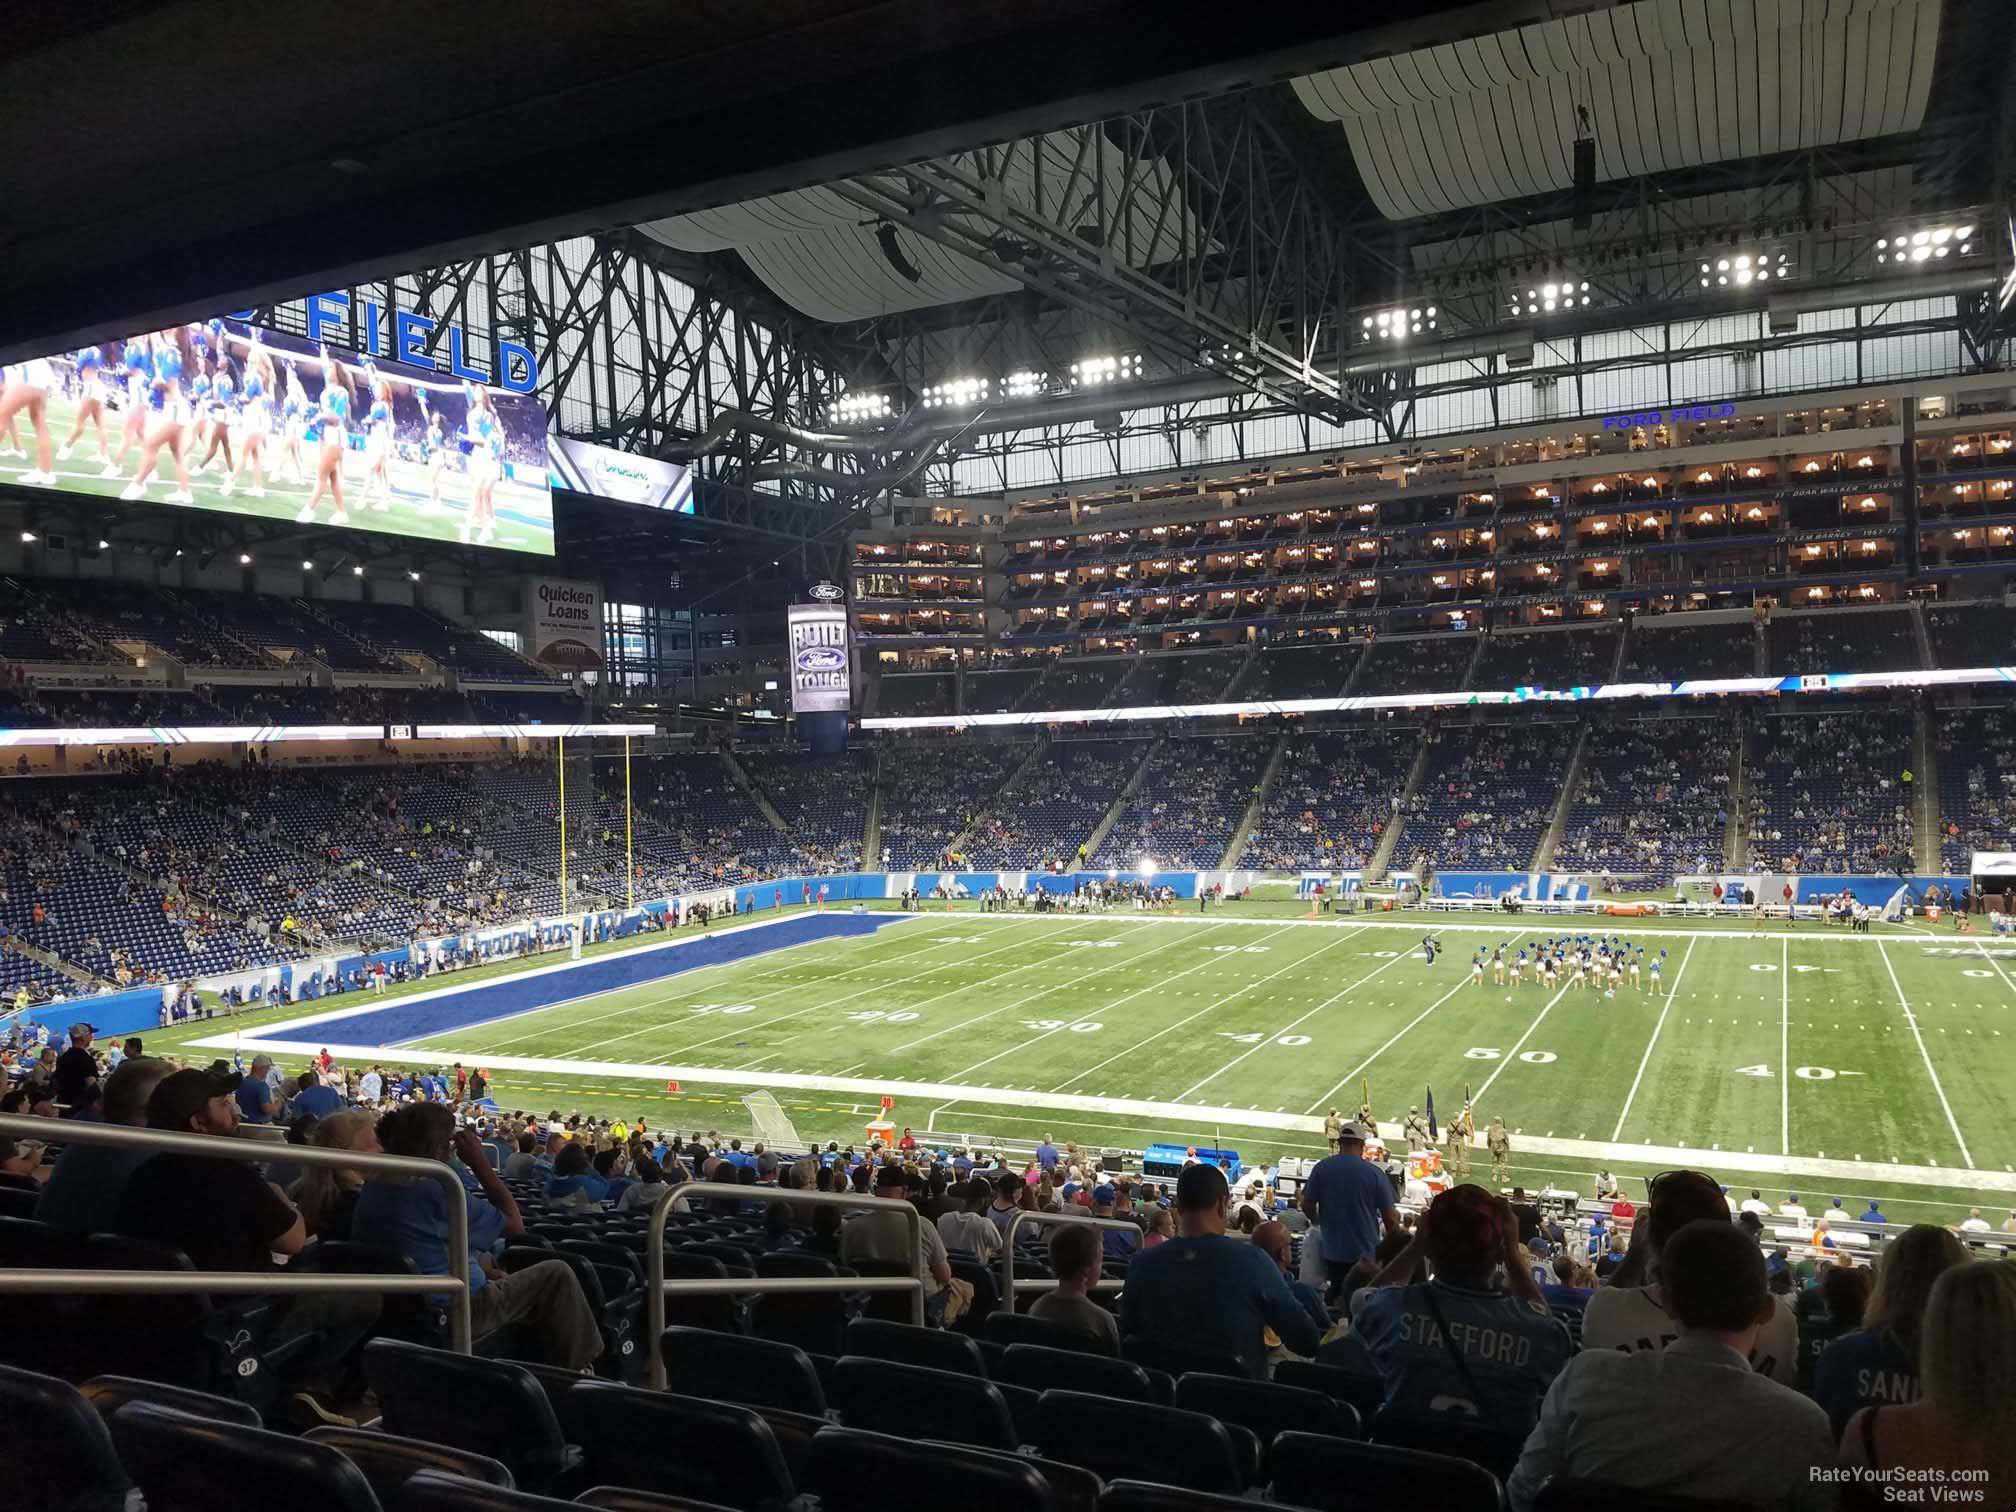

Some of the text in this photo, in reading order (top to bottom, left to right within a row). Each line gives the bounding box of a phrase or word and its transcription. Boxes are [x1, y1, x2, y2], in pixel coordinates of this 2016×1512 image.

[307, 291, 539, 394] FIELD
[1603, 402, 1736, 431] FORD FIELD
[539, 584, 594, 605] Quicken
[548, 602, 590, 620] Loans
[792, 623, 846, 648] BUILT
[796, 672, 848, 689] TOUGH
[1399, 1312, 1530, 1368] STAFFORD
